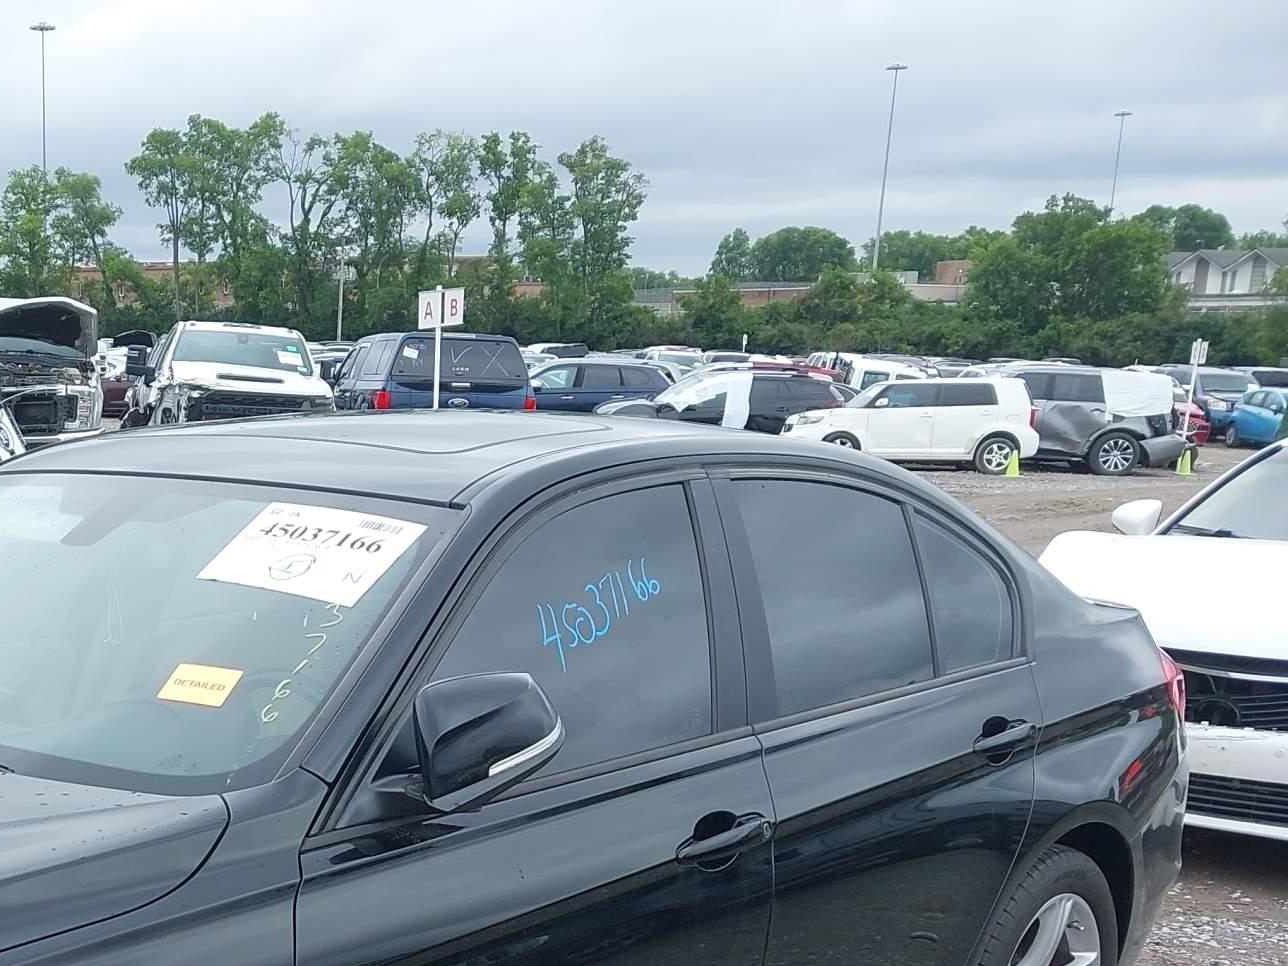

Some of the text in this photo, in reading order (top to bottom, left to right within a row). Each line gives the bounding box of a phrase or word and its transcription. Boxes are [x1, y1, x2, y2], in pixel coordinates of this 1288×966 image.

[424, 301, 433, 320] A
[450, 298, 458, 317] B
[259, 522, 386, 553] 45037166
[536, 557, 661, 673] 45037166
[173, 679, 227, 692] DETAILED
